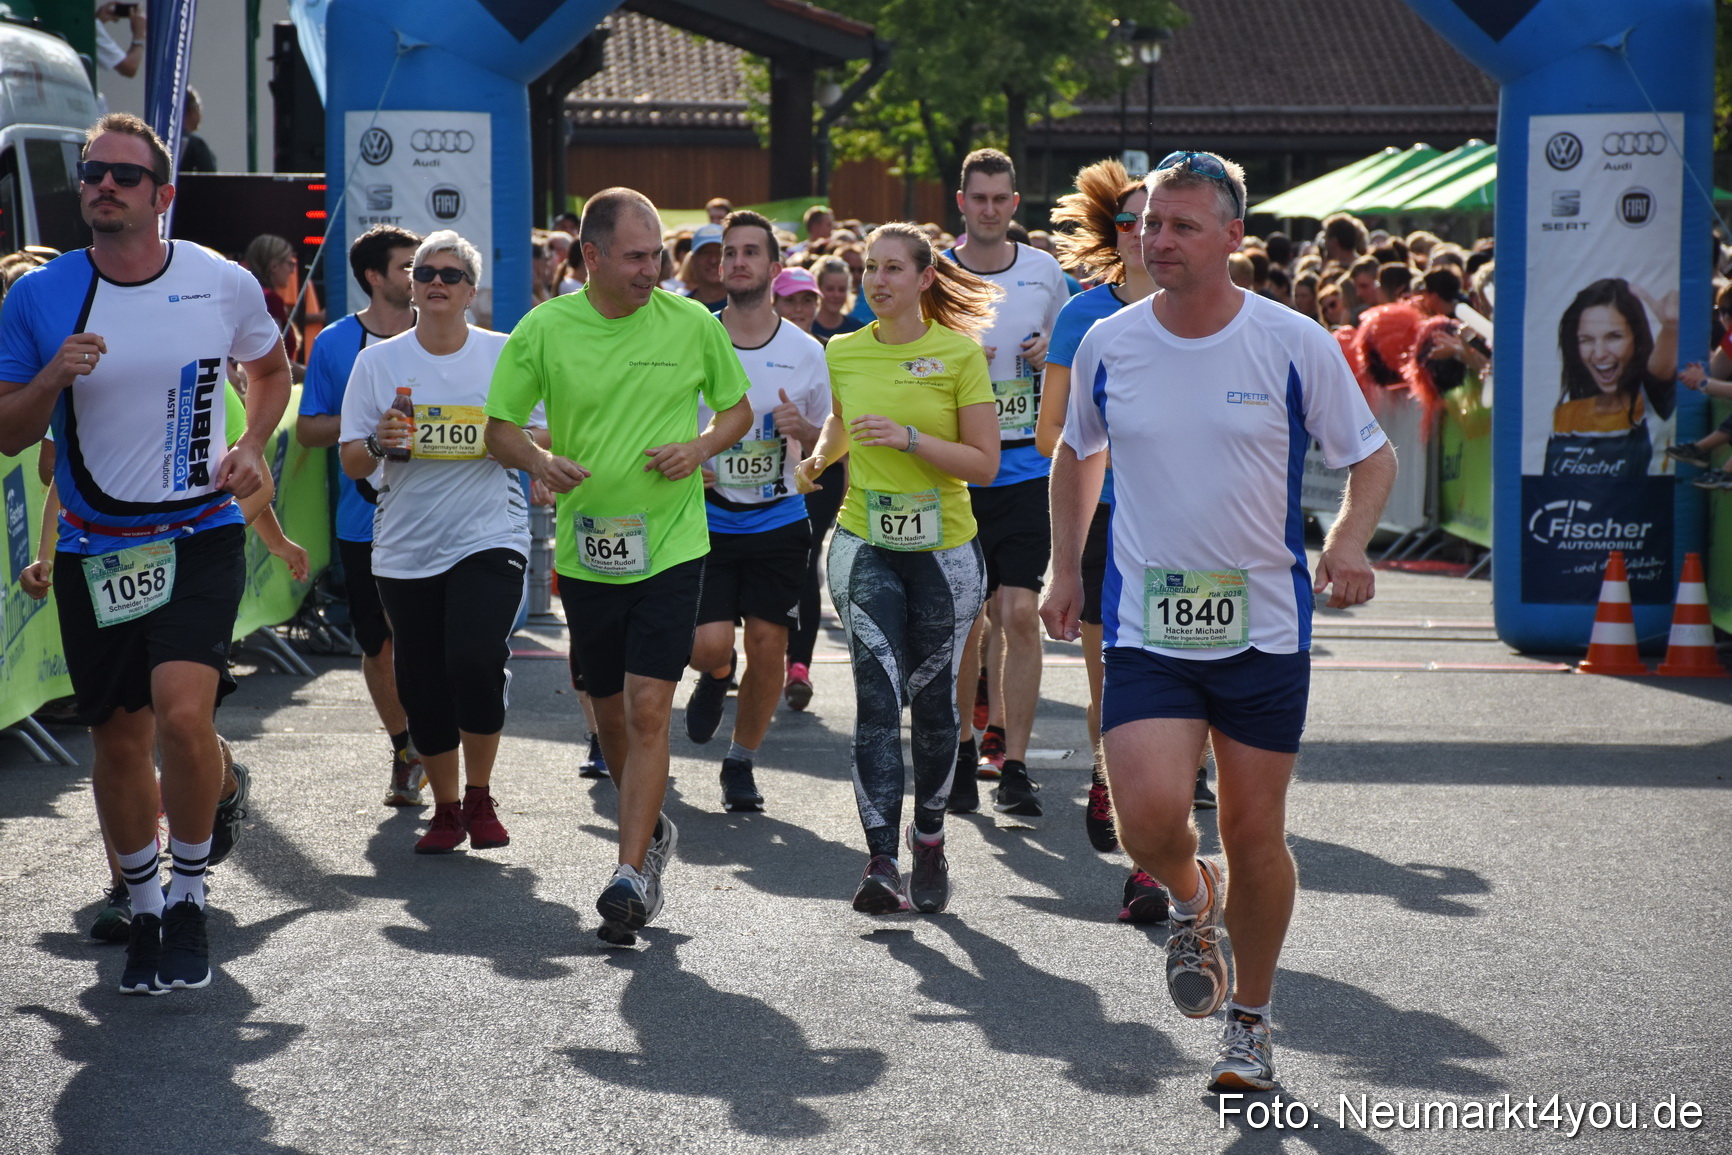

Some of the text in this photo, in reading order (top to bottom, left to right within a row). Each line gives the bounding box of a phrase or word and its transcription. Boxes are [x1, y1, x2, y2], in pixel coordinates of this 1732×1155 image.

[412, 158, 440, 167] Audi
[1603, 161, 1632, 171] Audi
[435, 194, 458, 214] FIAT
[1624, 198, 1648, 217] FIAT
[357, 216, 402, 225] SEAT
[1541, 222, 1590, 232] SEAT
[1243, 392, 1269, 401] PETTER
[187, 358, 221, 489] HUBER
[162, 388, 176, 488] WASTE WATER Solutions
[176, 386, 192, 485] TECHNOLOGY
[420, 424, 477, 444] 2160
[725, 456, 773, 474] 1053
[922, 504, 937, 512] 2019
[881, 513, 922, 535] 671
[1548, 517, 1653, 540] Fischer
[882, 533, 903, 542] Weikert
[1557, 540, 1644, 551] AUTOMOBILE
[585, 536, 629, 559] 664
[156, 557, 171, 567] 2019
[590, 557, 613, 566] Krauser
[102, 567, 166, 604] 1058
[1160, 584, 1200, 594] firmenlauf
[109, 592, 163, 613] Schneider Thomas
[1157, 598, 1234, 626] 1840
[1165, 627, 1226, 635] Hacker Michael
